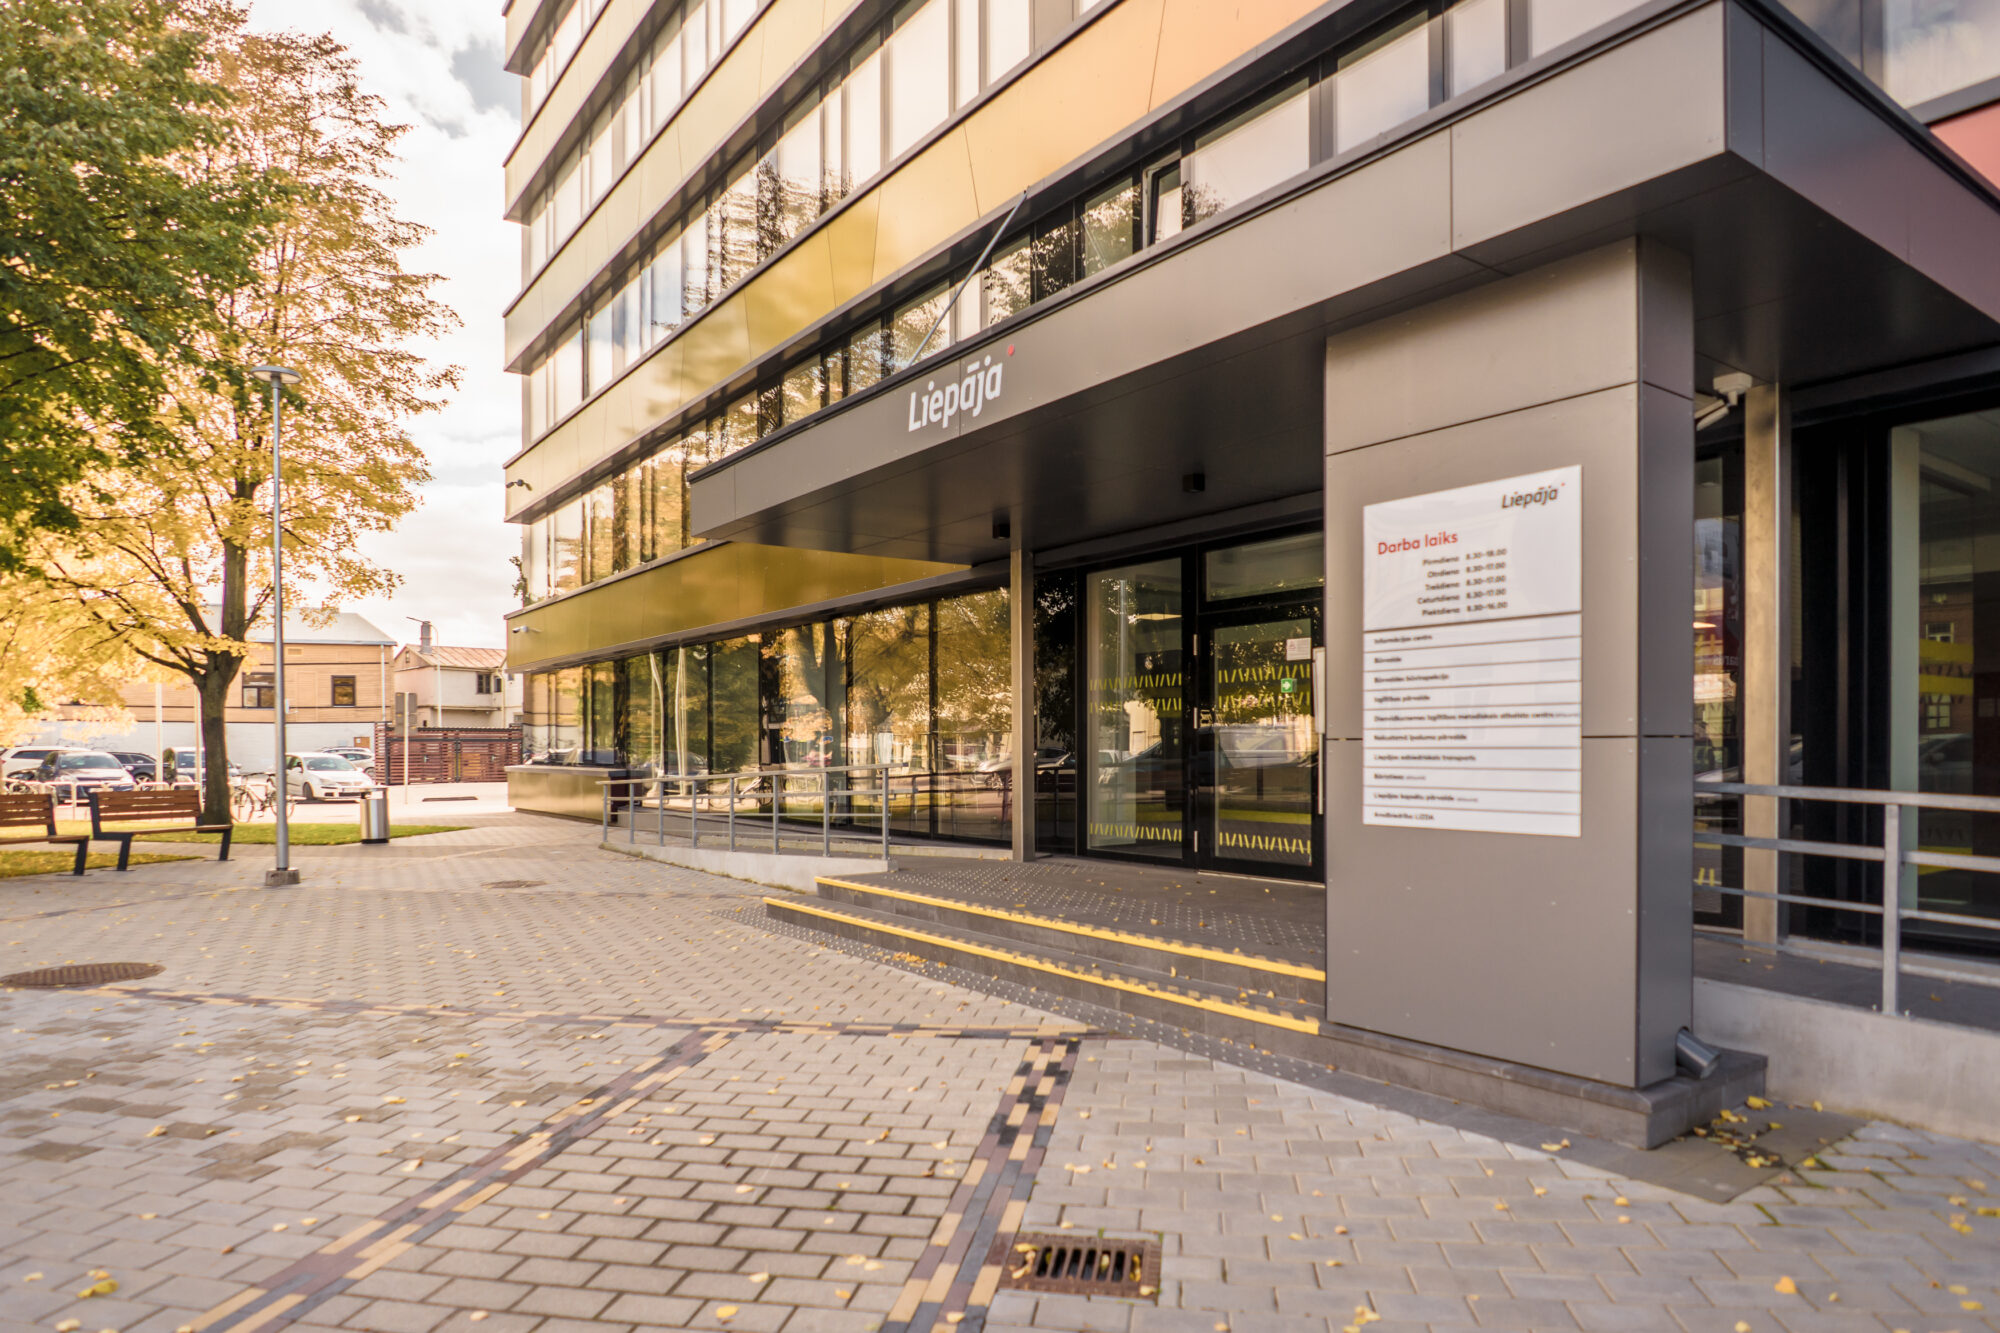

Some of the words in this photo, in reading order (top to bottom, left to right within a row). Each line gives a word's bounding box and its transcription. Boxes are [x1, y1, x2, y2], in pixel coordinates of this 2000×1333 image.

[908, 355, 1003, 432] Liepāja
[1501, 485, 1559, 509] Liepāja
[1377, 537, 1421, 555] Darba
[1424, 531, 1459, 548] laiks
